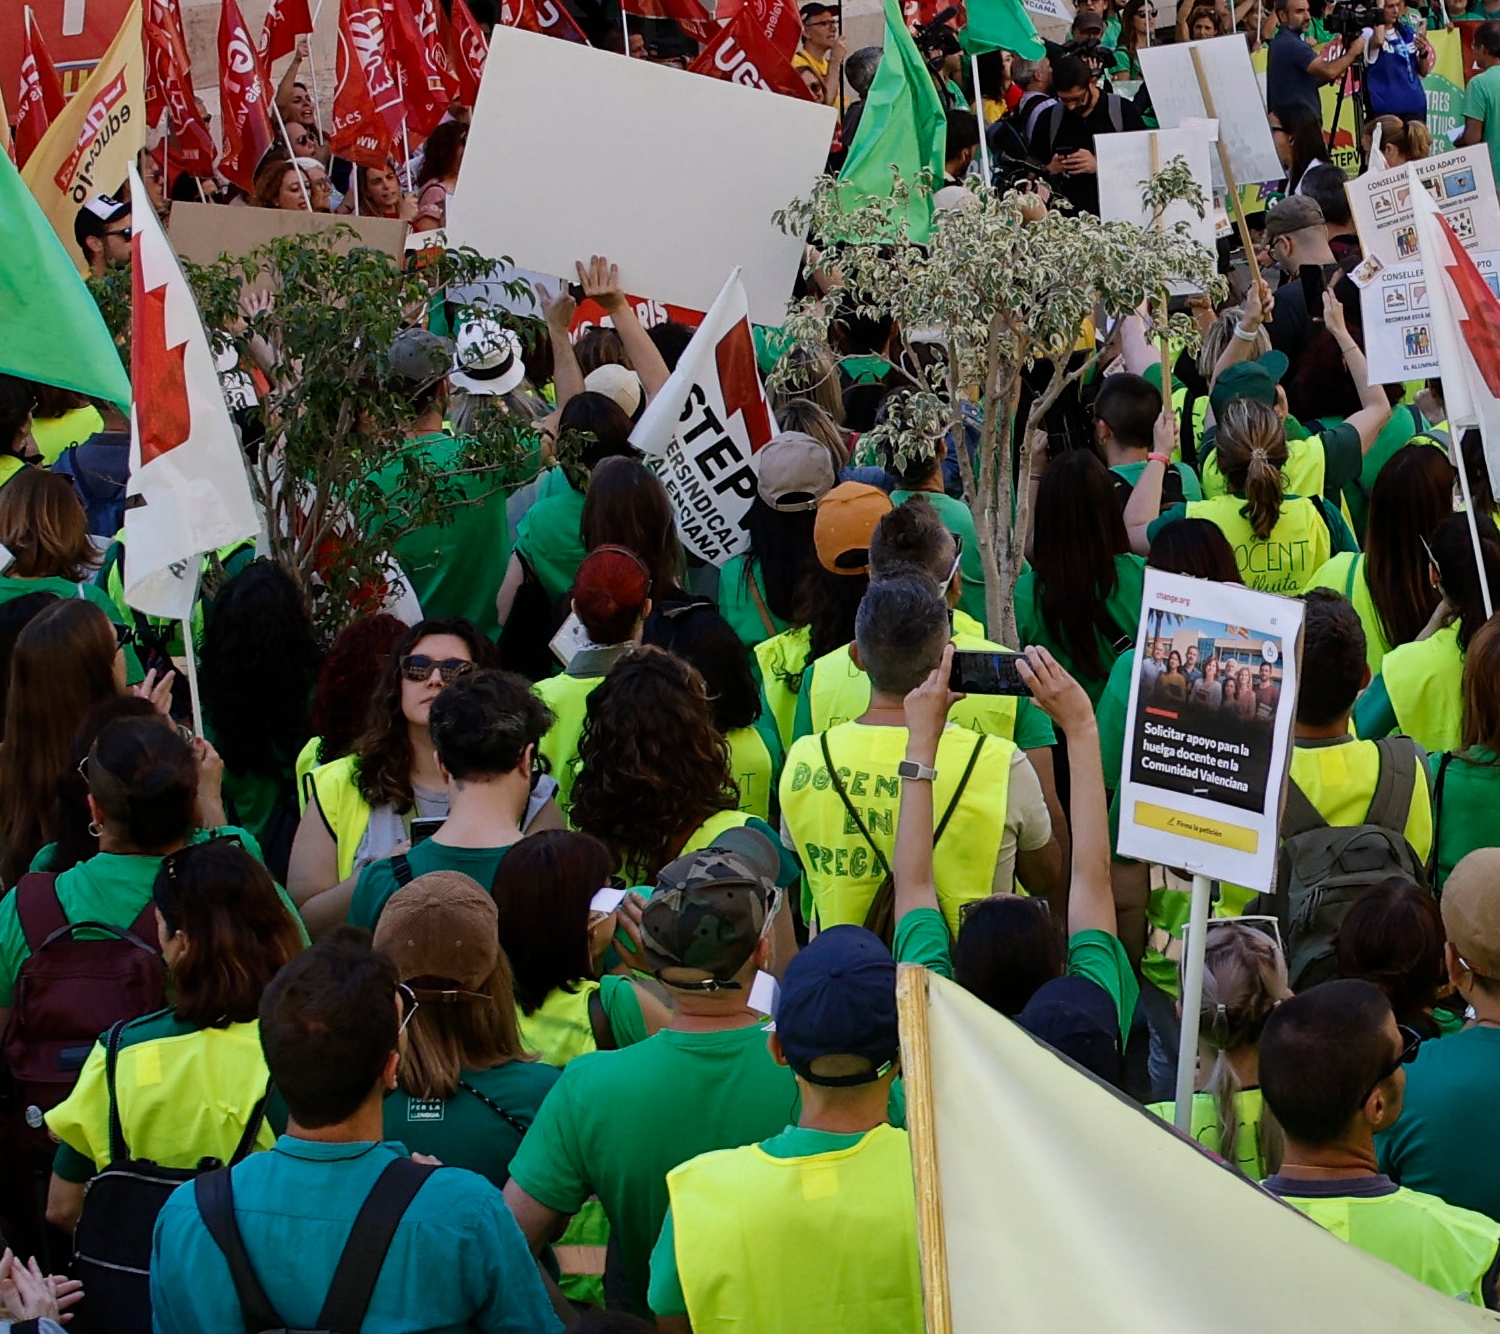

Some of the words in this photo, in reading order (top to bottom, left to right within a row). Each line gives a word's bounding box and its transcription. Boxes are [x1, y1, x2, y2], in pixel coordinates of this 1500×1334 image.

[1426, 164, 1436, 172] LO
[1437, 156, 1466, 170] ADAPTO
[678, 383, 759, 532] STEP
[1156, 591, 1190, 606] change.org
[1144, 722, 1185, 742] Solicitar
[1187, 732, 1216, 750] apoyo
[1217, 737, 1239, 753] para
[1240, 745, 1250, 756] la
[1143, 738, 1175, 758] huelga
[1177, 747, 1216, 767] docente
[1217, 758, 1230, 770] en
[1230, 759, 1239, 772] la
[1141, 756, 1198, 779] Comunidad
[1200, 771, 1249, 793] Valenciana
[843, 807, 894, 835] EN
[1176, 819, 1192, 829] Firma
[1193, 824, 1199, 832] la
[1199, 826, 1222, 838] petición
